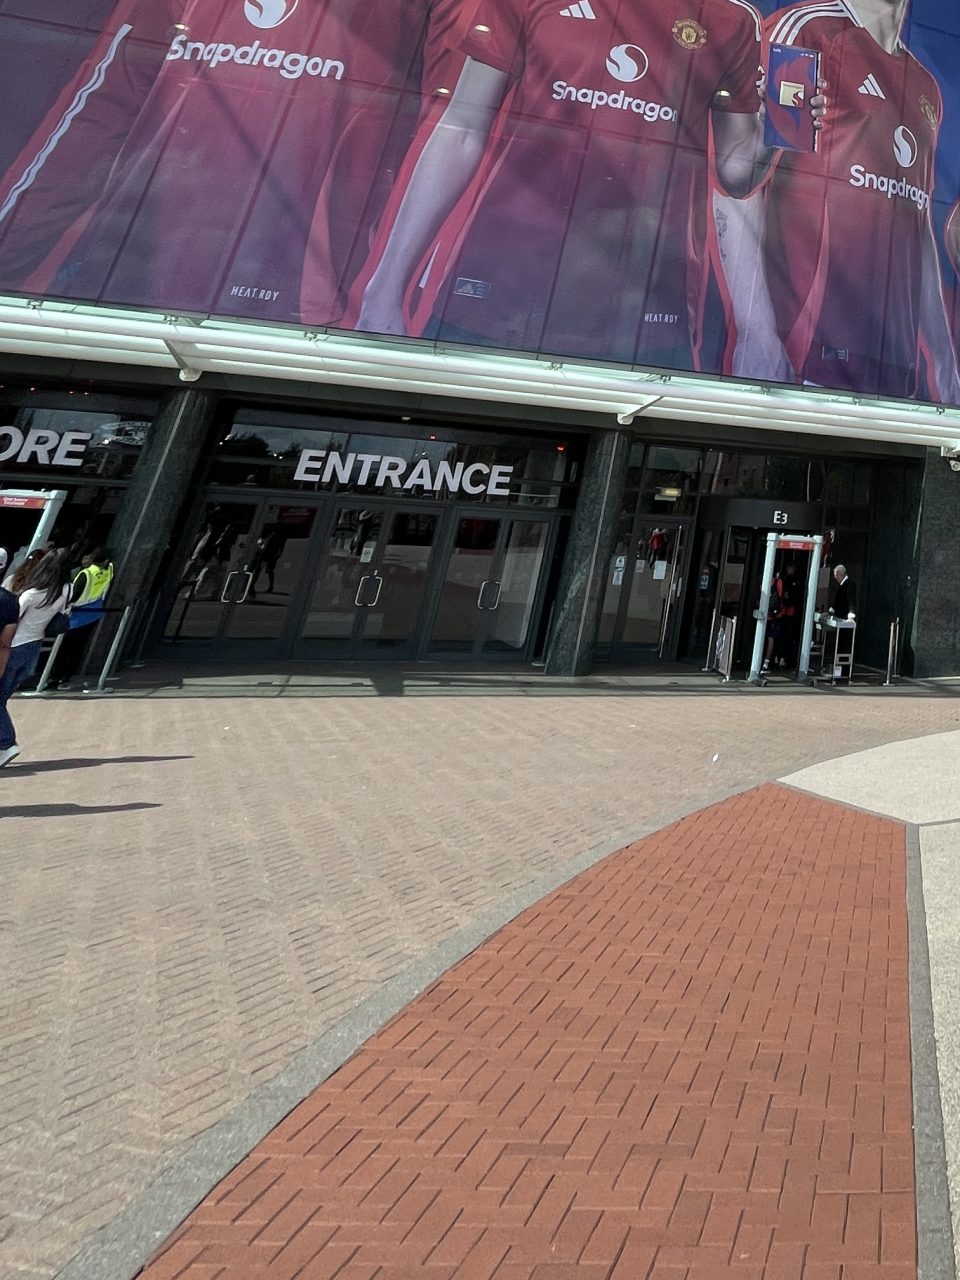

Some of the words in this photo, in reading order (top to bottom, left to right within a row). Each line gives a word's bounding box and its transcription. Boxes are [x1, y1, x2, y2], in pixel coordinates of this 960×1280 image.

[165, 33, 345, 81] Snapdragon
[293, 448, 514, 496] ENTRANCE
[773, 510, 788, 525] E3
